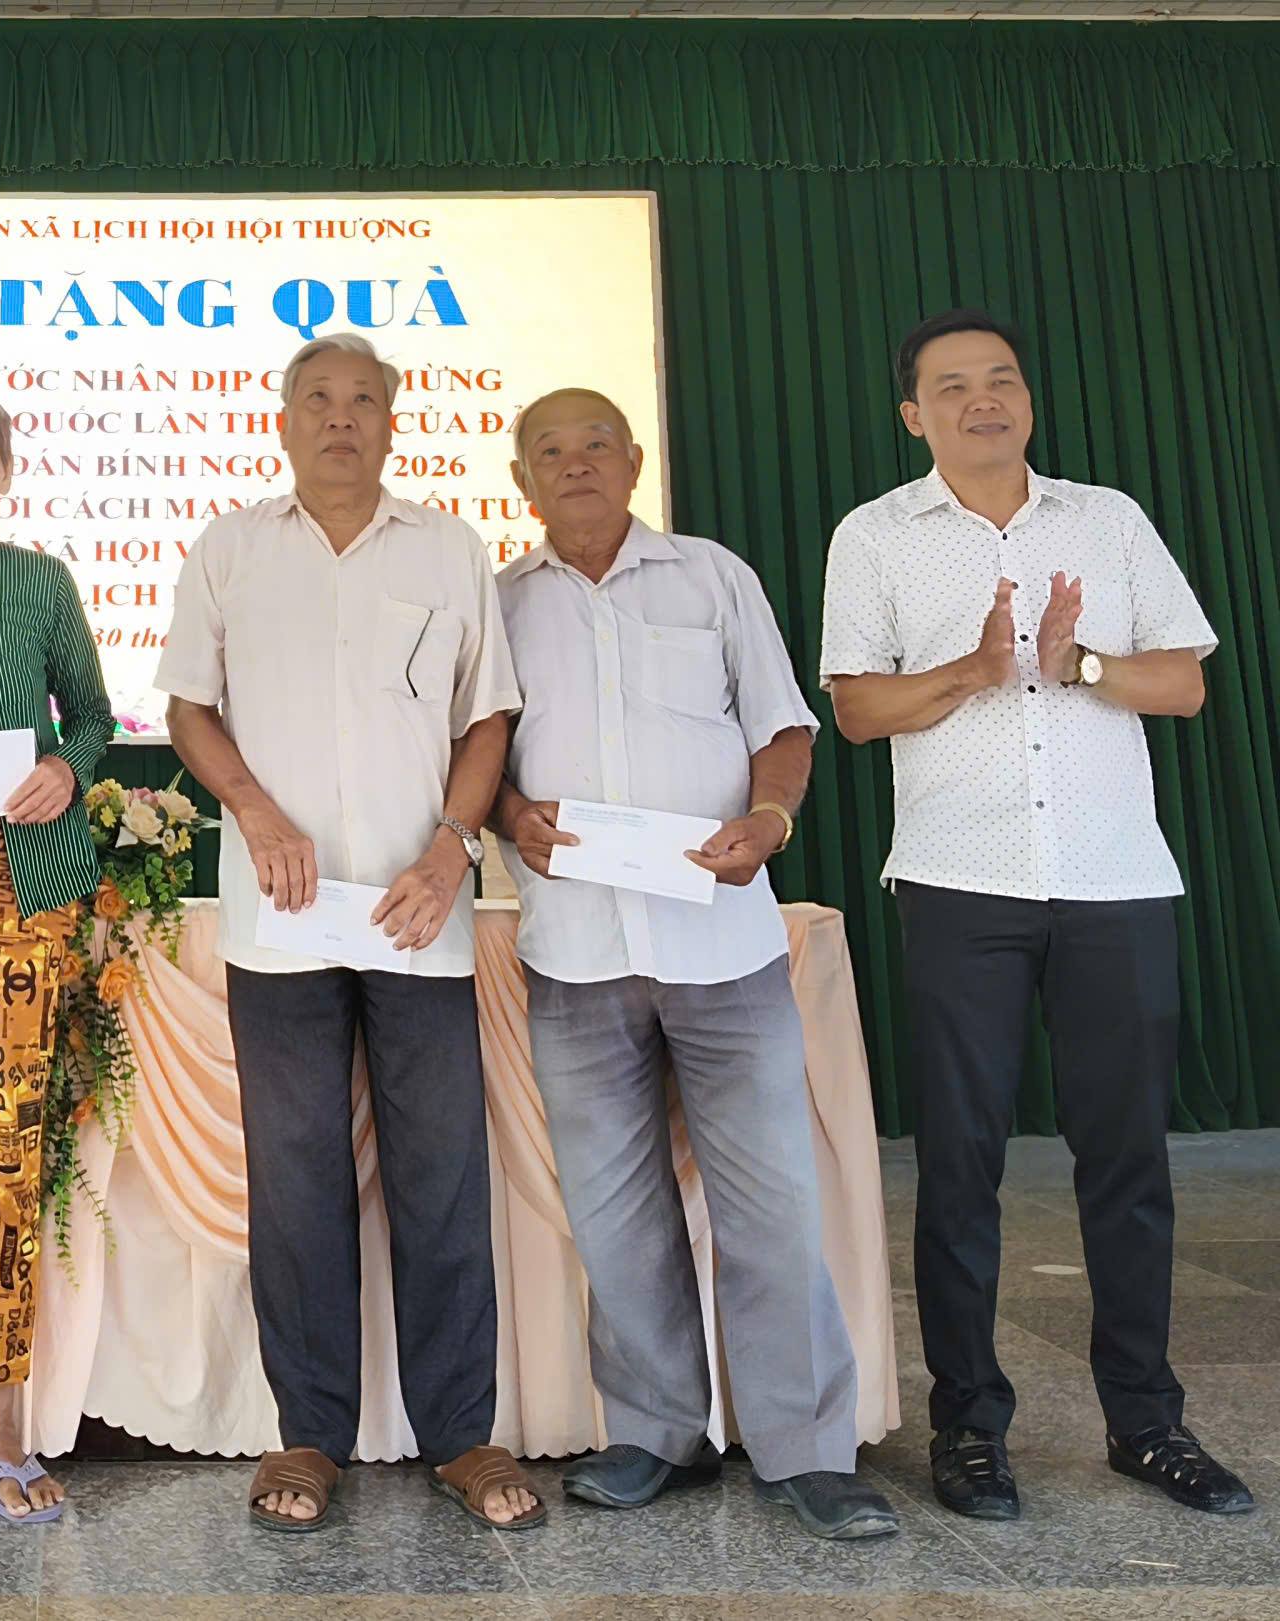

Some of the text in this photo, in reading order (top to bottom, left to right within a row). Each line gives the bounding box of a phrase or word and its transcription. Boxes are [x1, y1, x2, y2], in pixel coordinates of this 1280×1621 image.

[19, 215, 61, 239] XÃ
[72, 219, 148, 244] LỊCH
[159, 217, 215, 245] HỘI
[226, 217, 284, 245] HỘI
[292, 217, 433, 244] THƯỢNG
[271, 265, 470, 341] QUÀ
[73, 363, 177, 392] NHÂN
[191, 370, 253, 398] DỊP
[11, 405, 122, 438] QUỐC
[135, 404, 208, 434] LẦN
[391, 405, 470, 434] CỦA
[97, 447, 186, 477] BÍNH
[199, 454, 283, 483] NGỌ
[393, 454, 467, 478] 2026
[44, 490, 150, 519] CÁCH
[95, 536, 161, 569] HỘI
